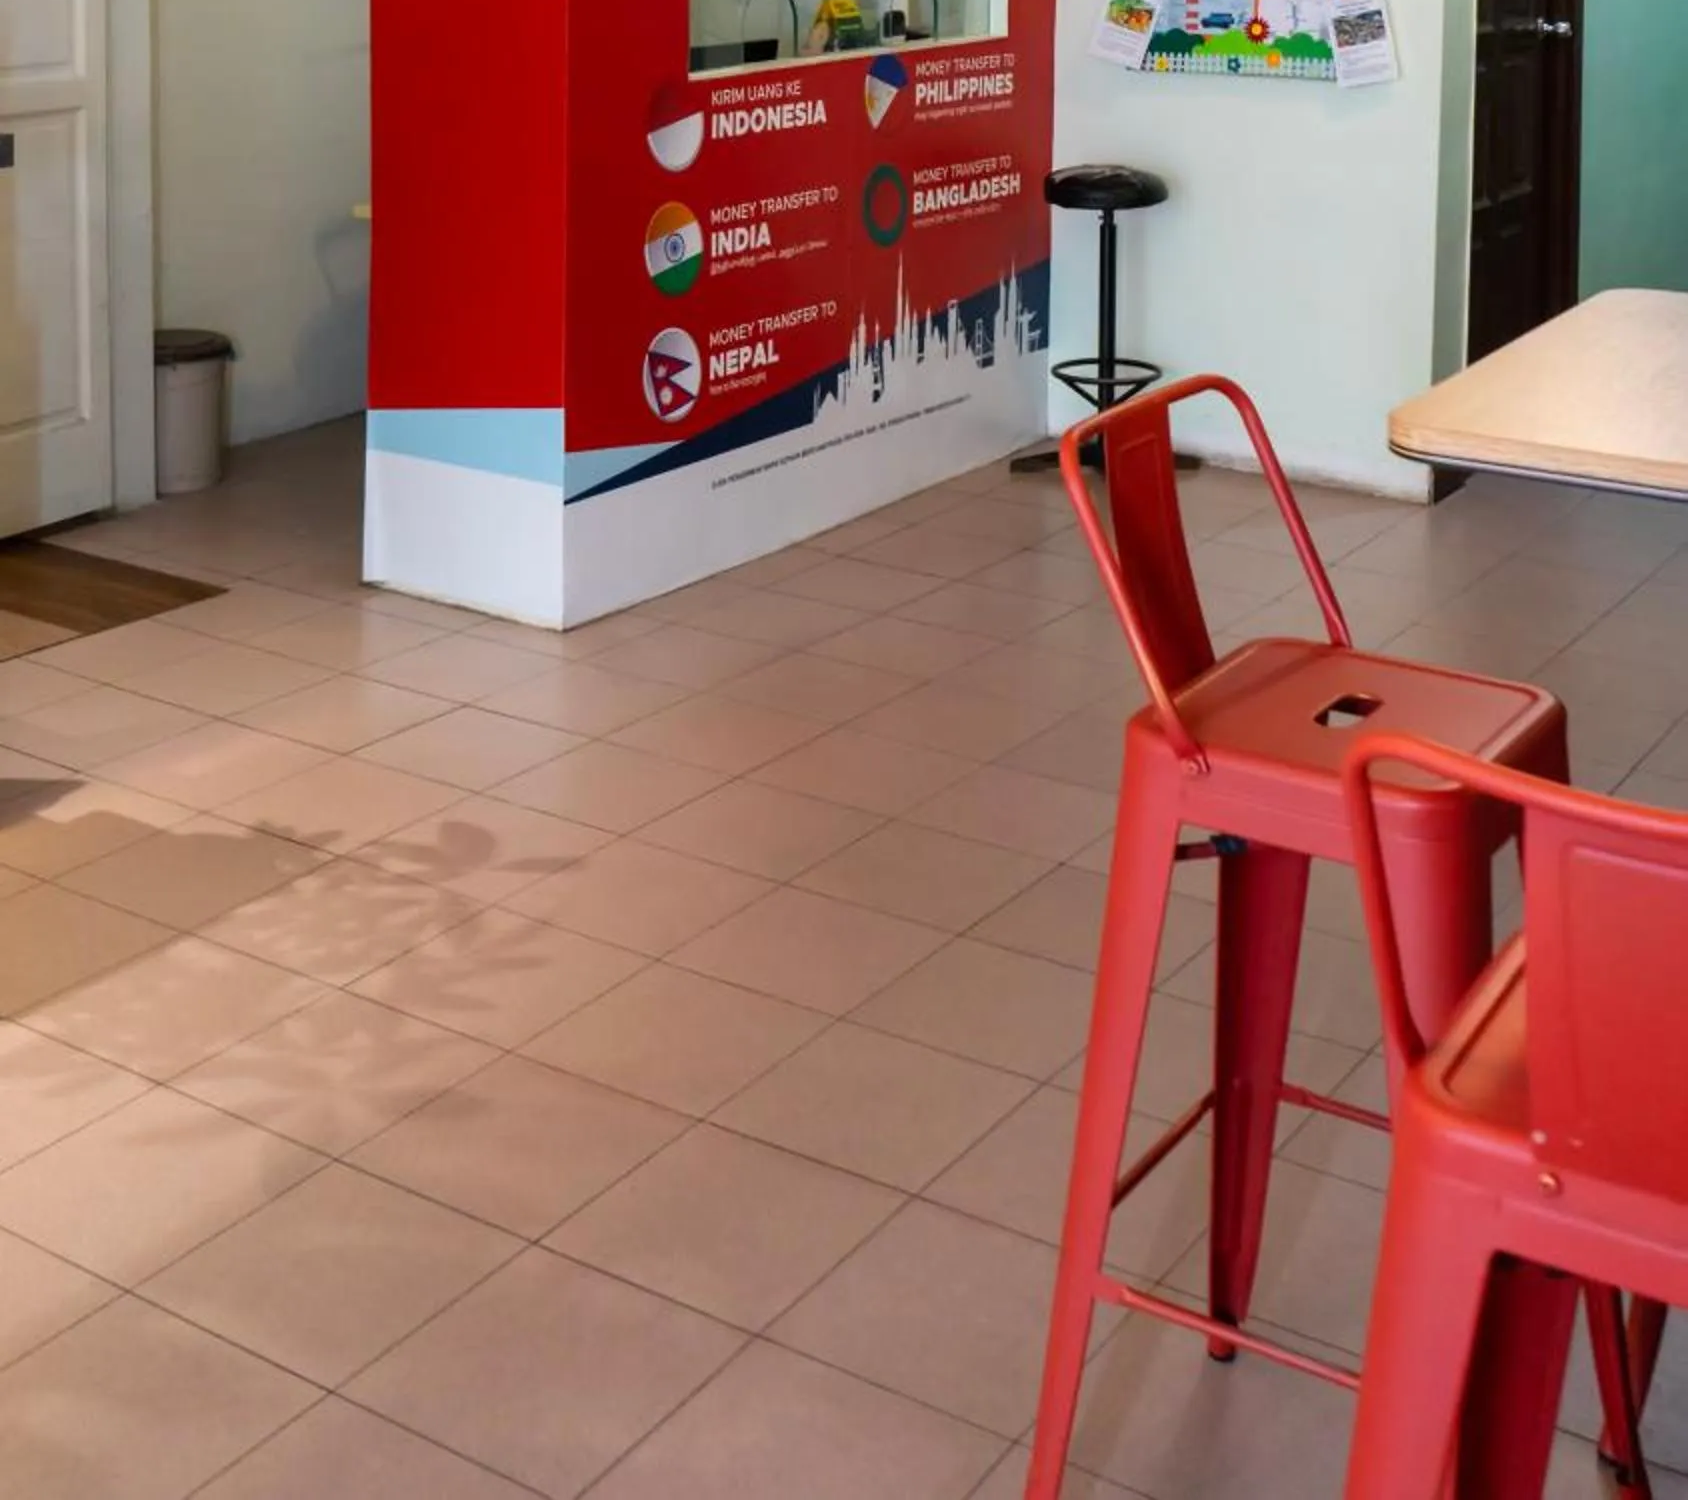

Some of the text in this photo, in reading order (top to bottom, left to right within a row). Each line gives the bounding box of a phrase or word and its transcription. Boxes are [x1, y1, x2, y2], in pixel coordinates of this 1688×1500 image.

[915, 53, 1015, 77] MONEY TRANSFER TO
[711, 80, 801, 106] KIRIM UANG KE
[915, 73, 1014, 107] PHILIPPINES
[710, 100, 827, 139] INDONESIA
[913, 155, 1012, 186] MONEY TRANSFER TO
[710, 186, 838, 224] MONEY TRANSFER TO
[912, 173, 1022, 216] BANGLADESH
[710, 221, 771, 258] INDIA
[709, 300, 837, 348] MONEY TRANSFER TO
[709, 339, 779, 381] NEPAL
